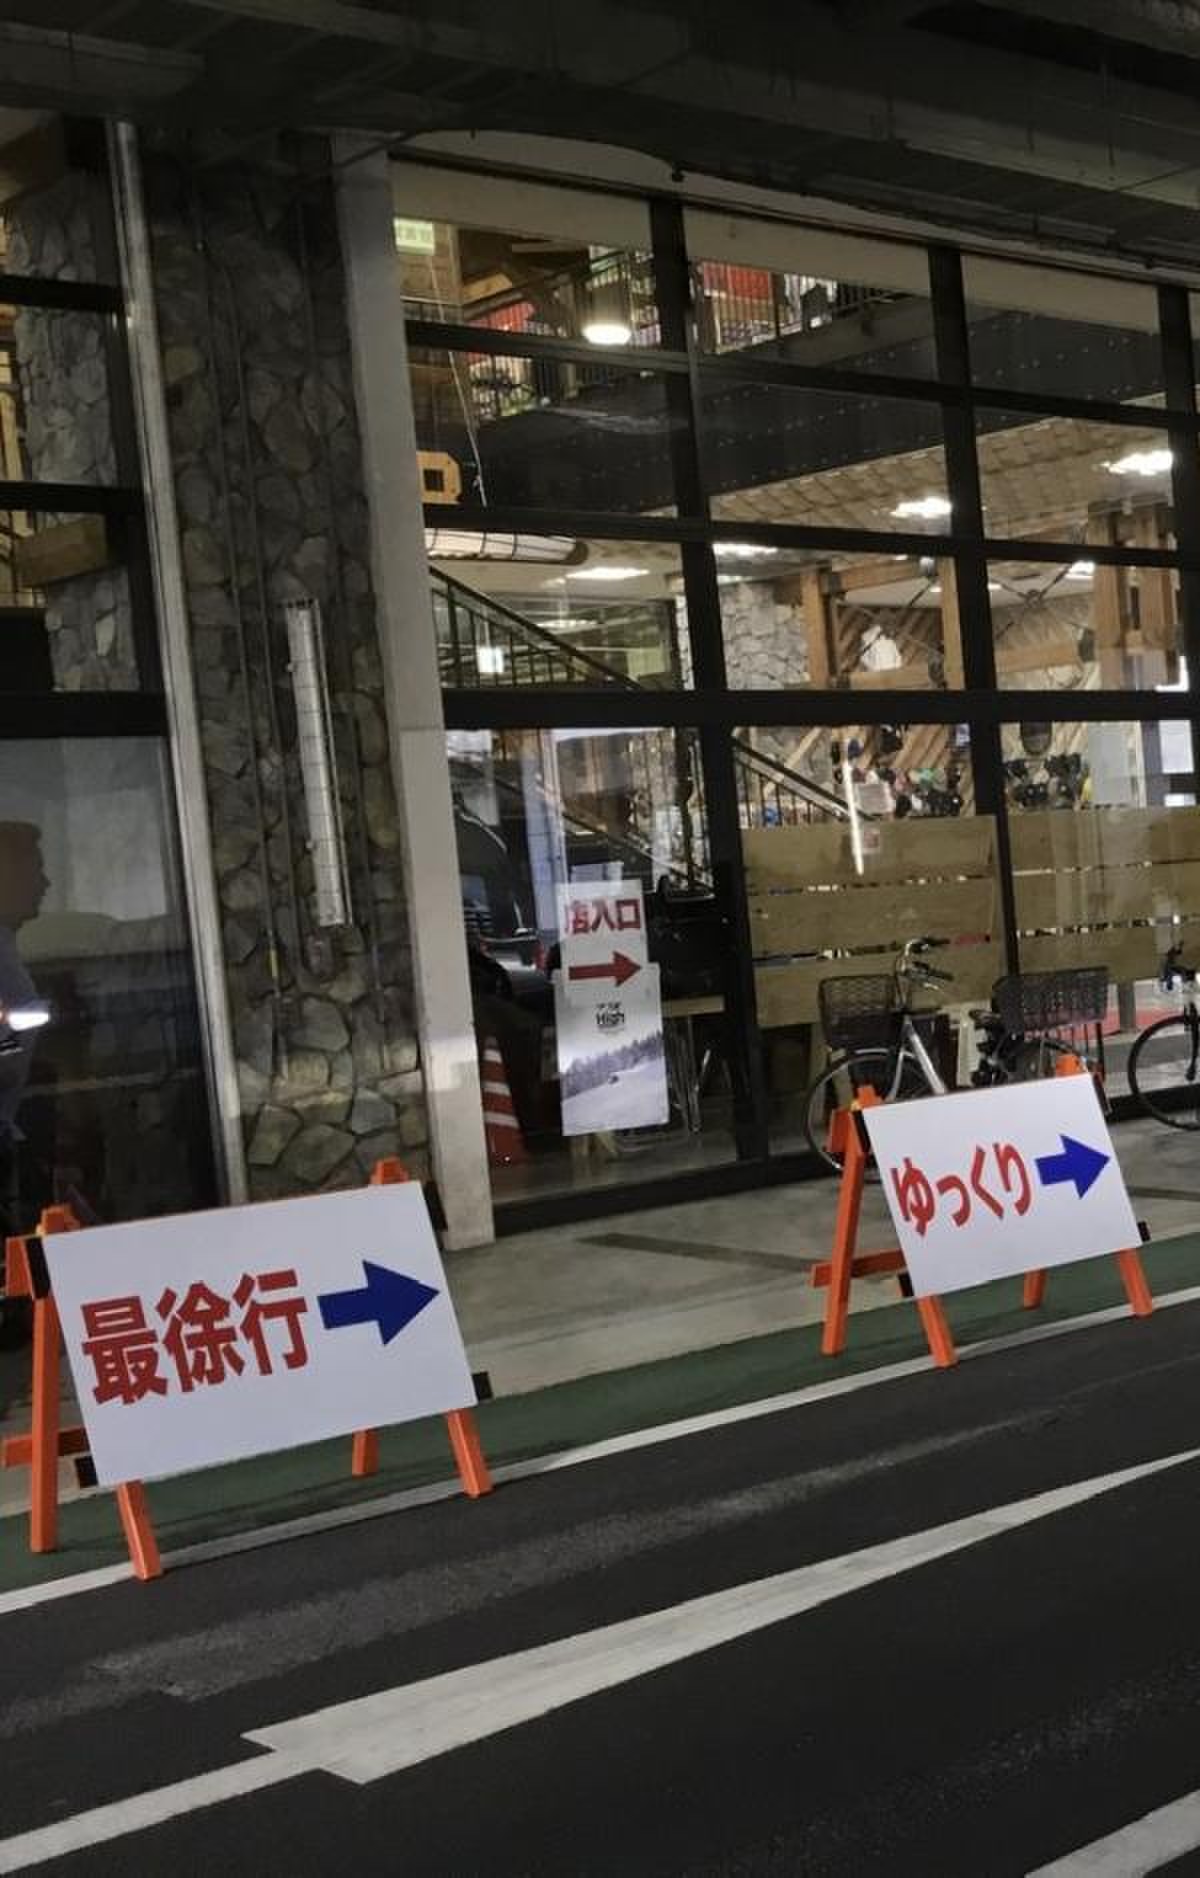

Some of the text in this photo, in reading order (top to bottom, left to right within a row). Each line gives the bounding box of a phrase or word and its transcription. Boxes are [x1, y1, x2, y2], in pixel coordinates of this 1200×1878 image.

[890, 1142, 1033, 1237] ゆっくり
[81, 1269, 308, 1405] 最徐行
